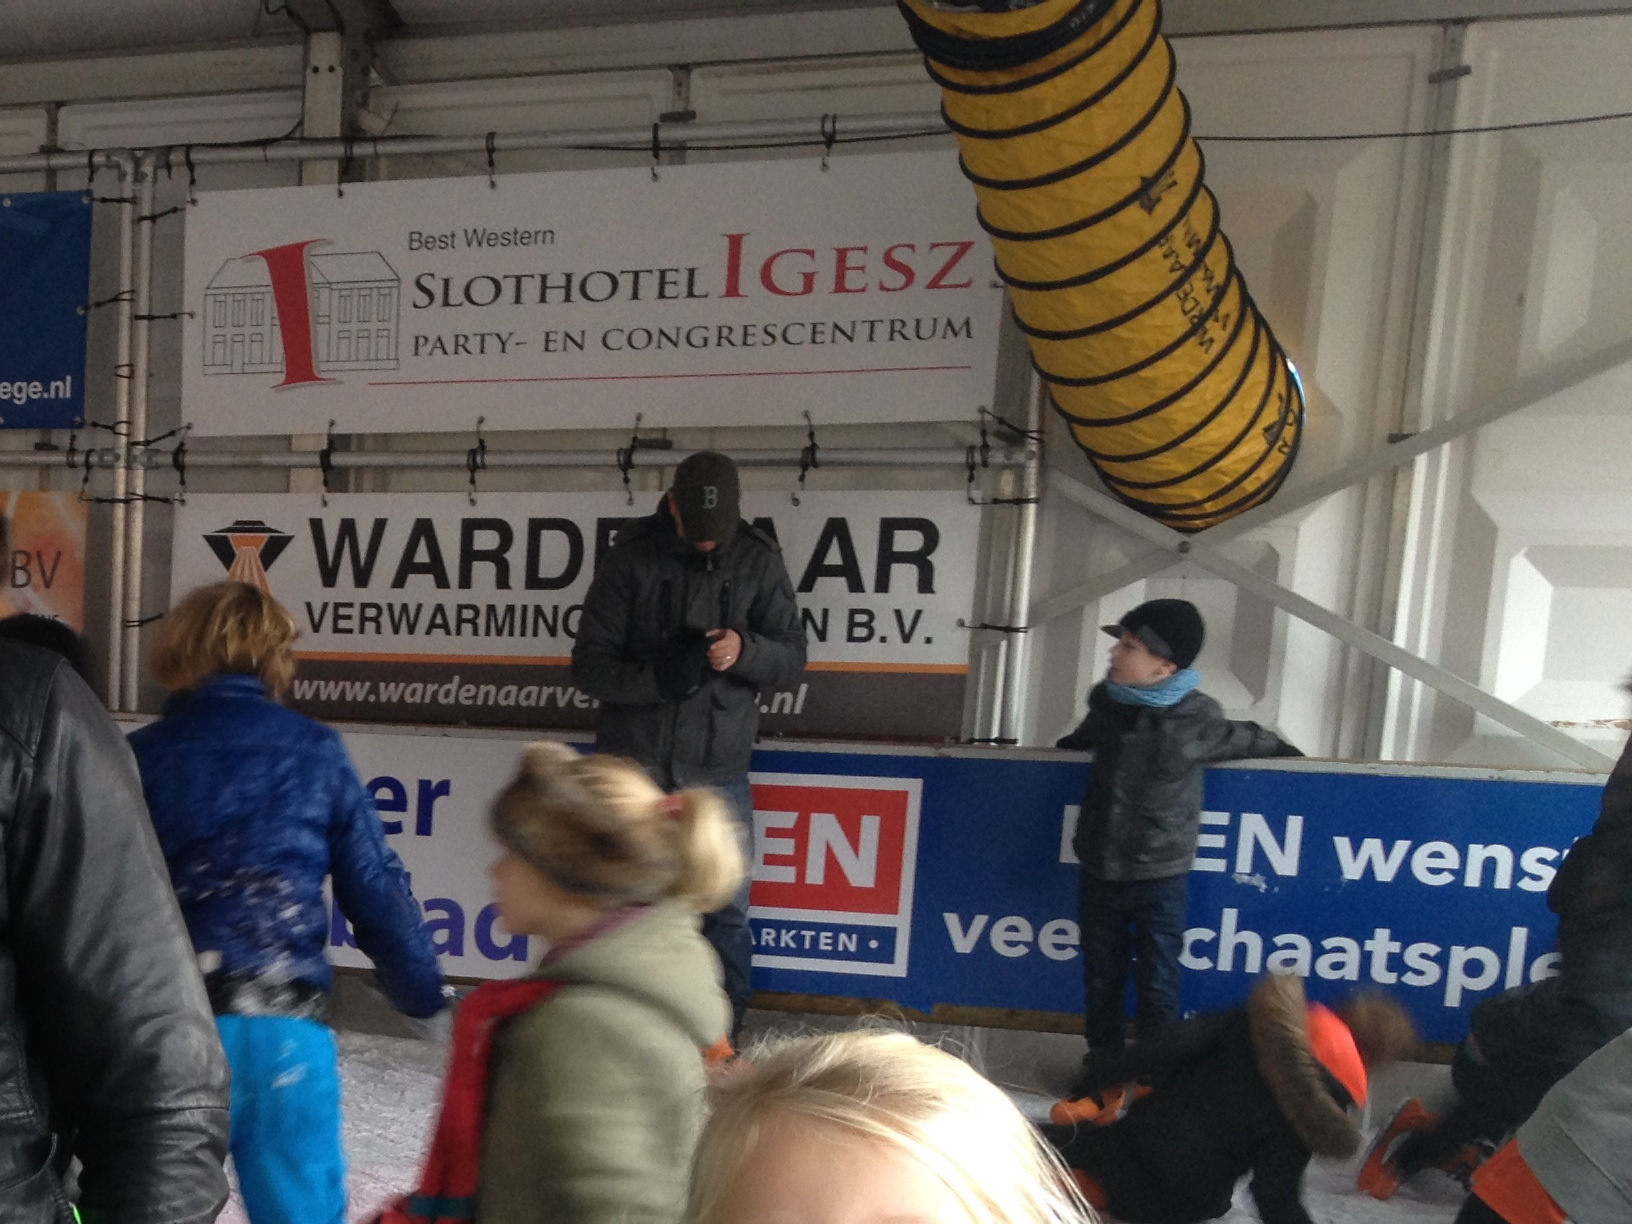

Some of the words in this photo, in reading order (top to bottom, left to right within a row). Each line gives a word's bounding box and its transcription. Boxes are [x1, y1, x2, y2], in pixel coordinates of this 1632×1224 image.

[408, 229, 456, 252] Best
[464, 227, 556, 249] Western
[412, 266, 710, 310] SLOTHOTEL
[718, 232, 975, 299] IGESZ
[411, 331, 527, 357] PARTY-
[543, 328, 587, 353] EN
[601, 316, 974, 352] CONGRESCENTRUM
[702, 485, 719, 509] B
[9, 548, 62, 590] BV
[308, 516, 941, 594] WARDAR
[846, 608, 934, 645] B.V.
[367, 775, 451, 837] er
[751, 809, 881, 888] EN
[1059, 803, 1304, 877] EN
[1332, 835, 1576, 893] wens
[751, 927, 858, 952] RKTEN
[942, 911, 1081, 961] vee
